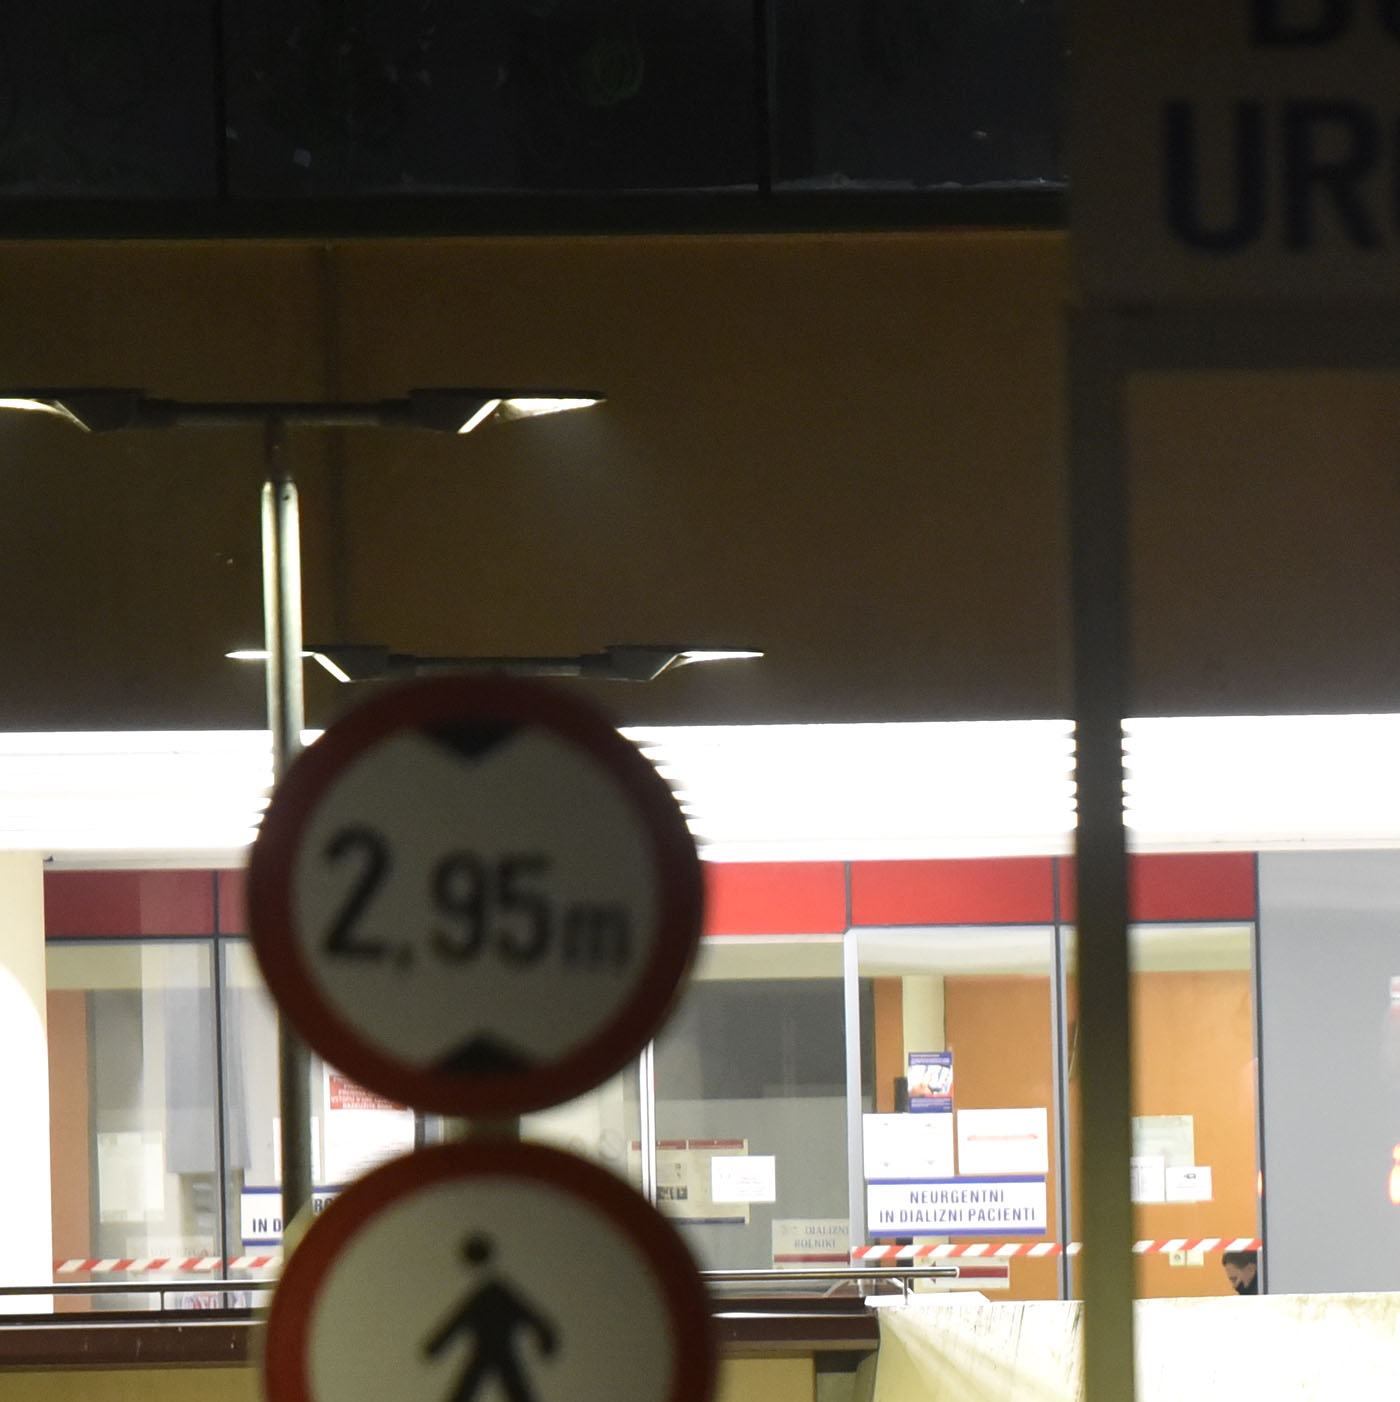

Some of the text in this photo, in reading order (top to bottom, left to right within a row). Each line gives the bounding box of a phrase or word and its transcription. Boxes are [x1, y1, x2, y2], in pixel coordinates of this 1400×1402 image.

[909, 1189, 1004, 1204] NEURGENTNI
[879, 1207, 1035, 1223] IN DIALIZNI PACIENTI
[252, 1218, 268, 1233] IN
